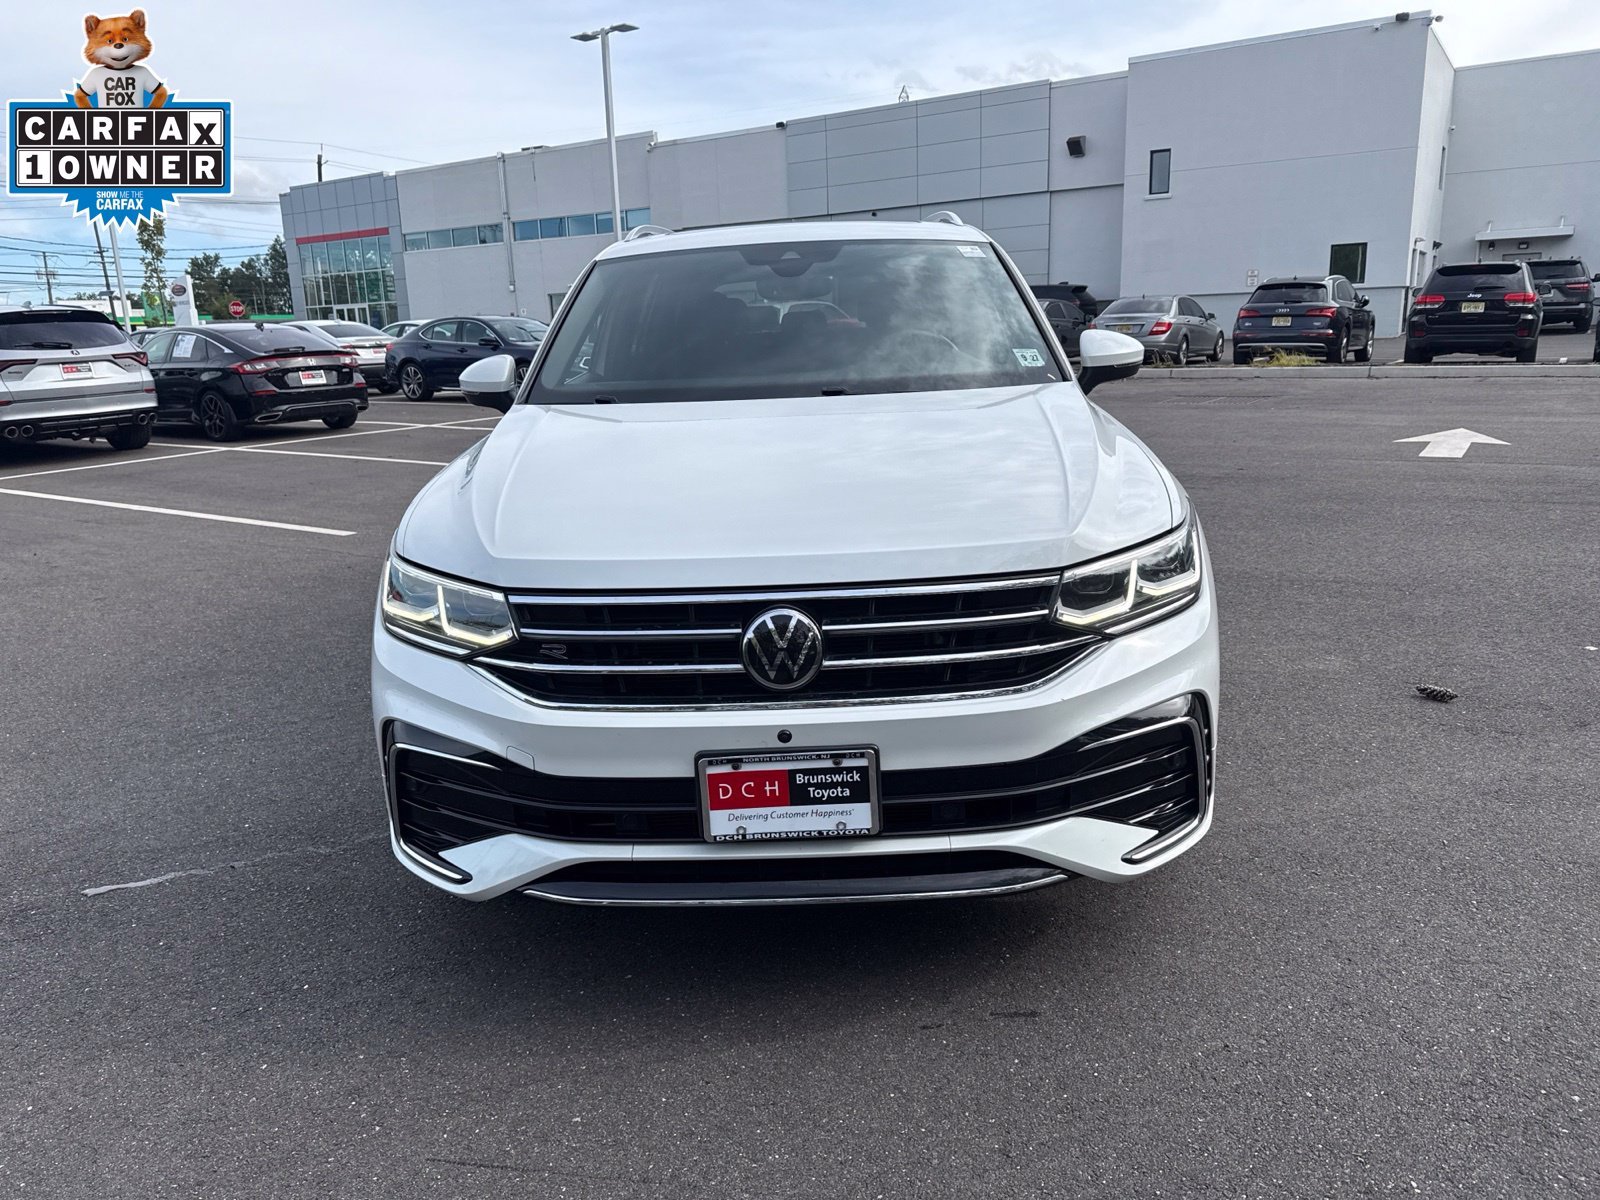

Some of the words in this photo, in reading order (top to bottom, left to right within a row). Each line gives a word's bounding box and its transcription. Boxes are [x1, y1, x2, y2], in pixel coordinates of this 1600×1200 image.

[230, 305, 244, 313] STOP
[796, 770, 861, 784] Brunswick
[808, 786, 850, 801] Toyota
[728, 811, 769, 822] Delivering
[770, 810, 809, 820] Customer
[716, 834, 743, 842] DCH
[746, 830, 819, 840] BRUNSWICK
[822, 828, 870, 836] TOYOTA
